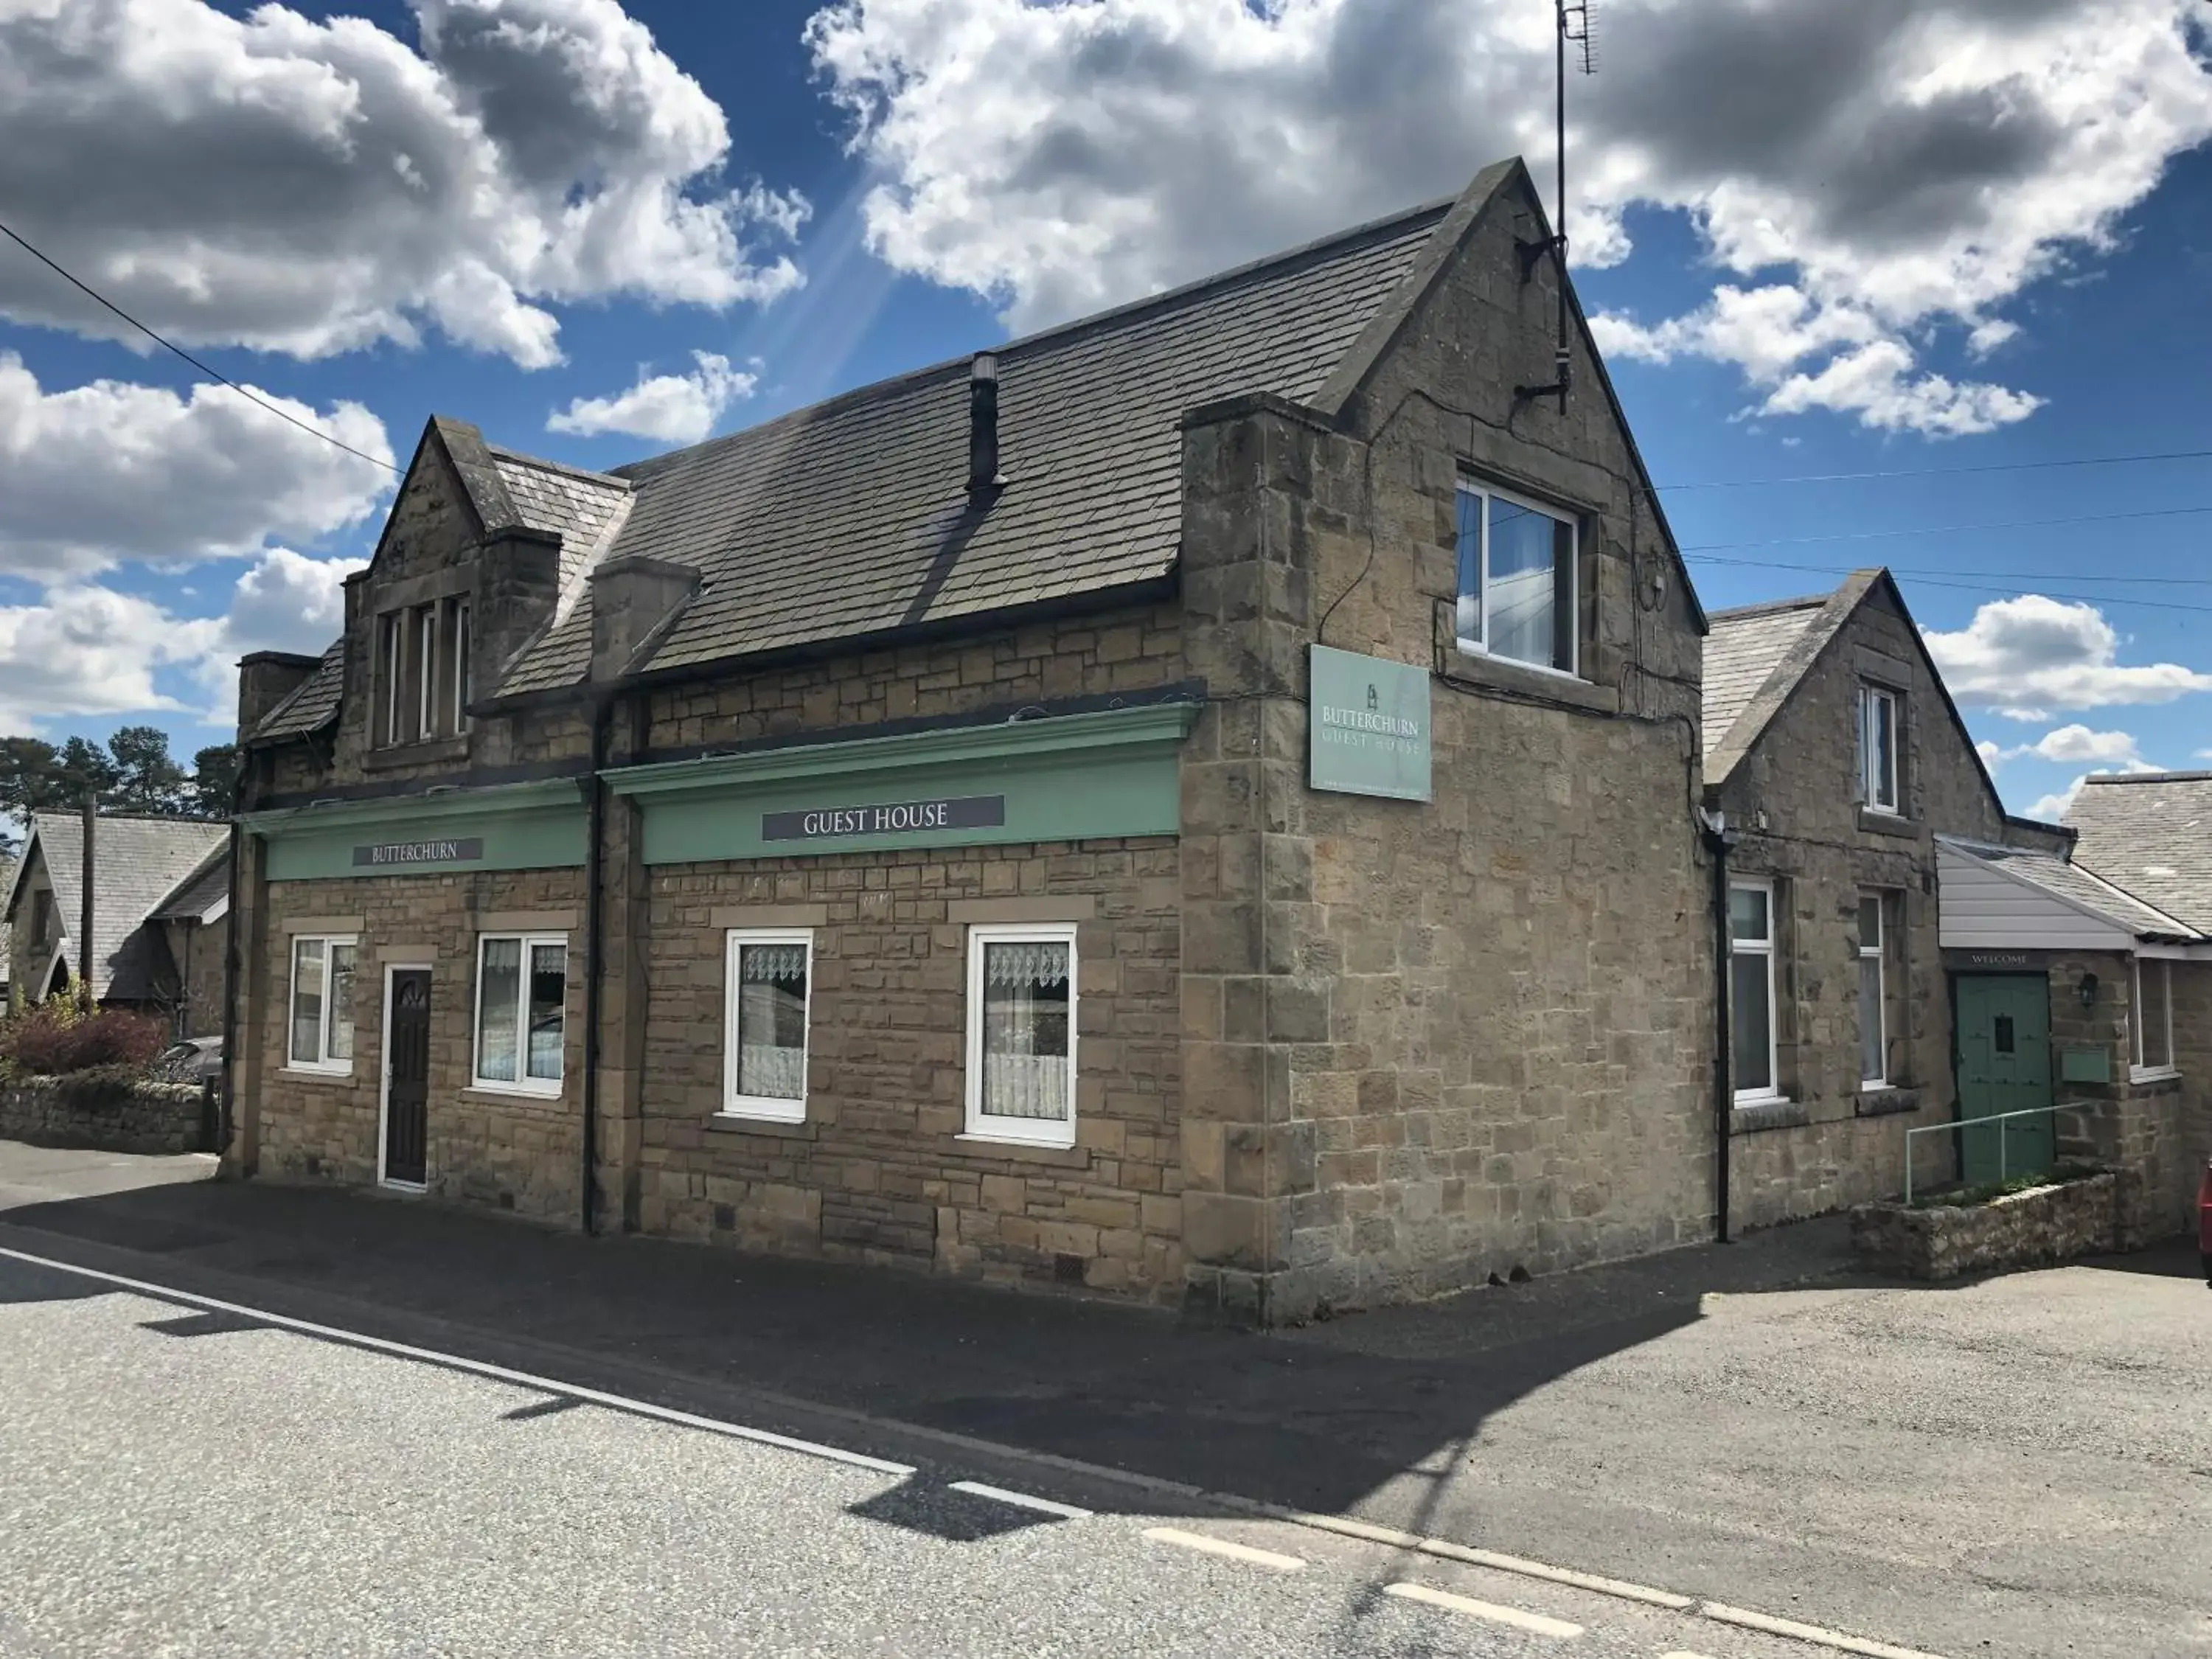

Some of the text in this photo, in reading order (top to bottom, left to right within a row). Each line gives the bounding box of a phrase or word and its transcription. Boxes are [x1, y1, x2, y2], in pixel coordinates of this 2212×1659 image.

[1323, 705, 1419, 737] BUTTERCHURN
[1322, 728, 1366, 748] GUEST
[804, 803, 947, 834] GUEST HOUSE
[372, 841, 458, 863] BUTTERCHURN
[1971, 954, 2026, 964] WELCOME
